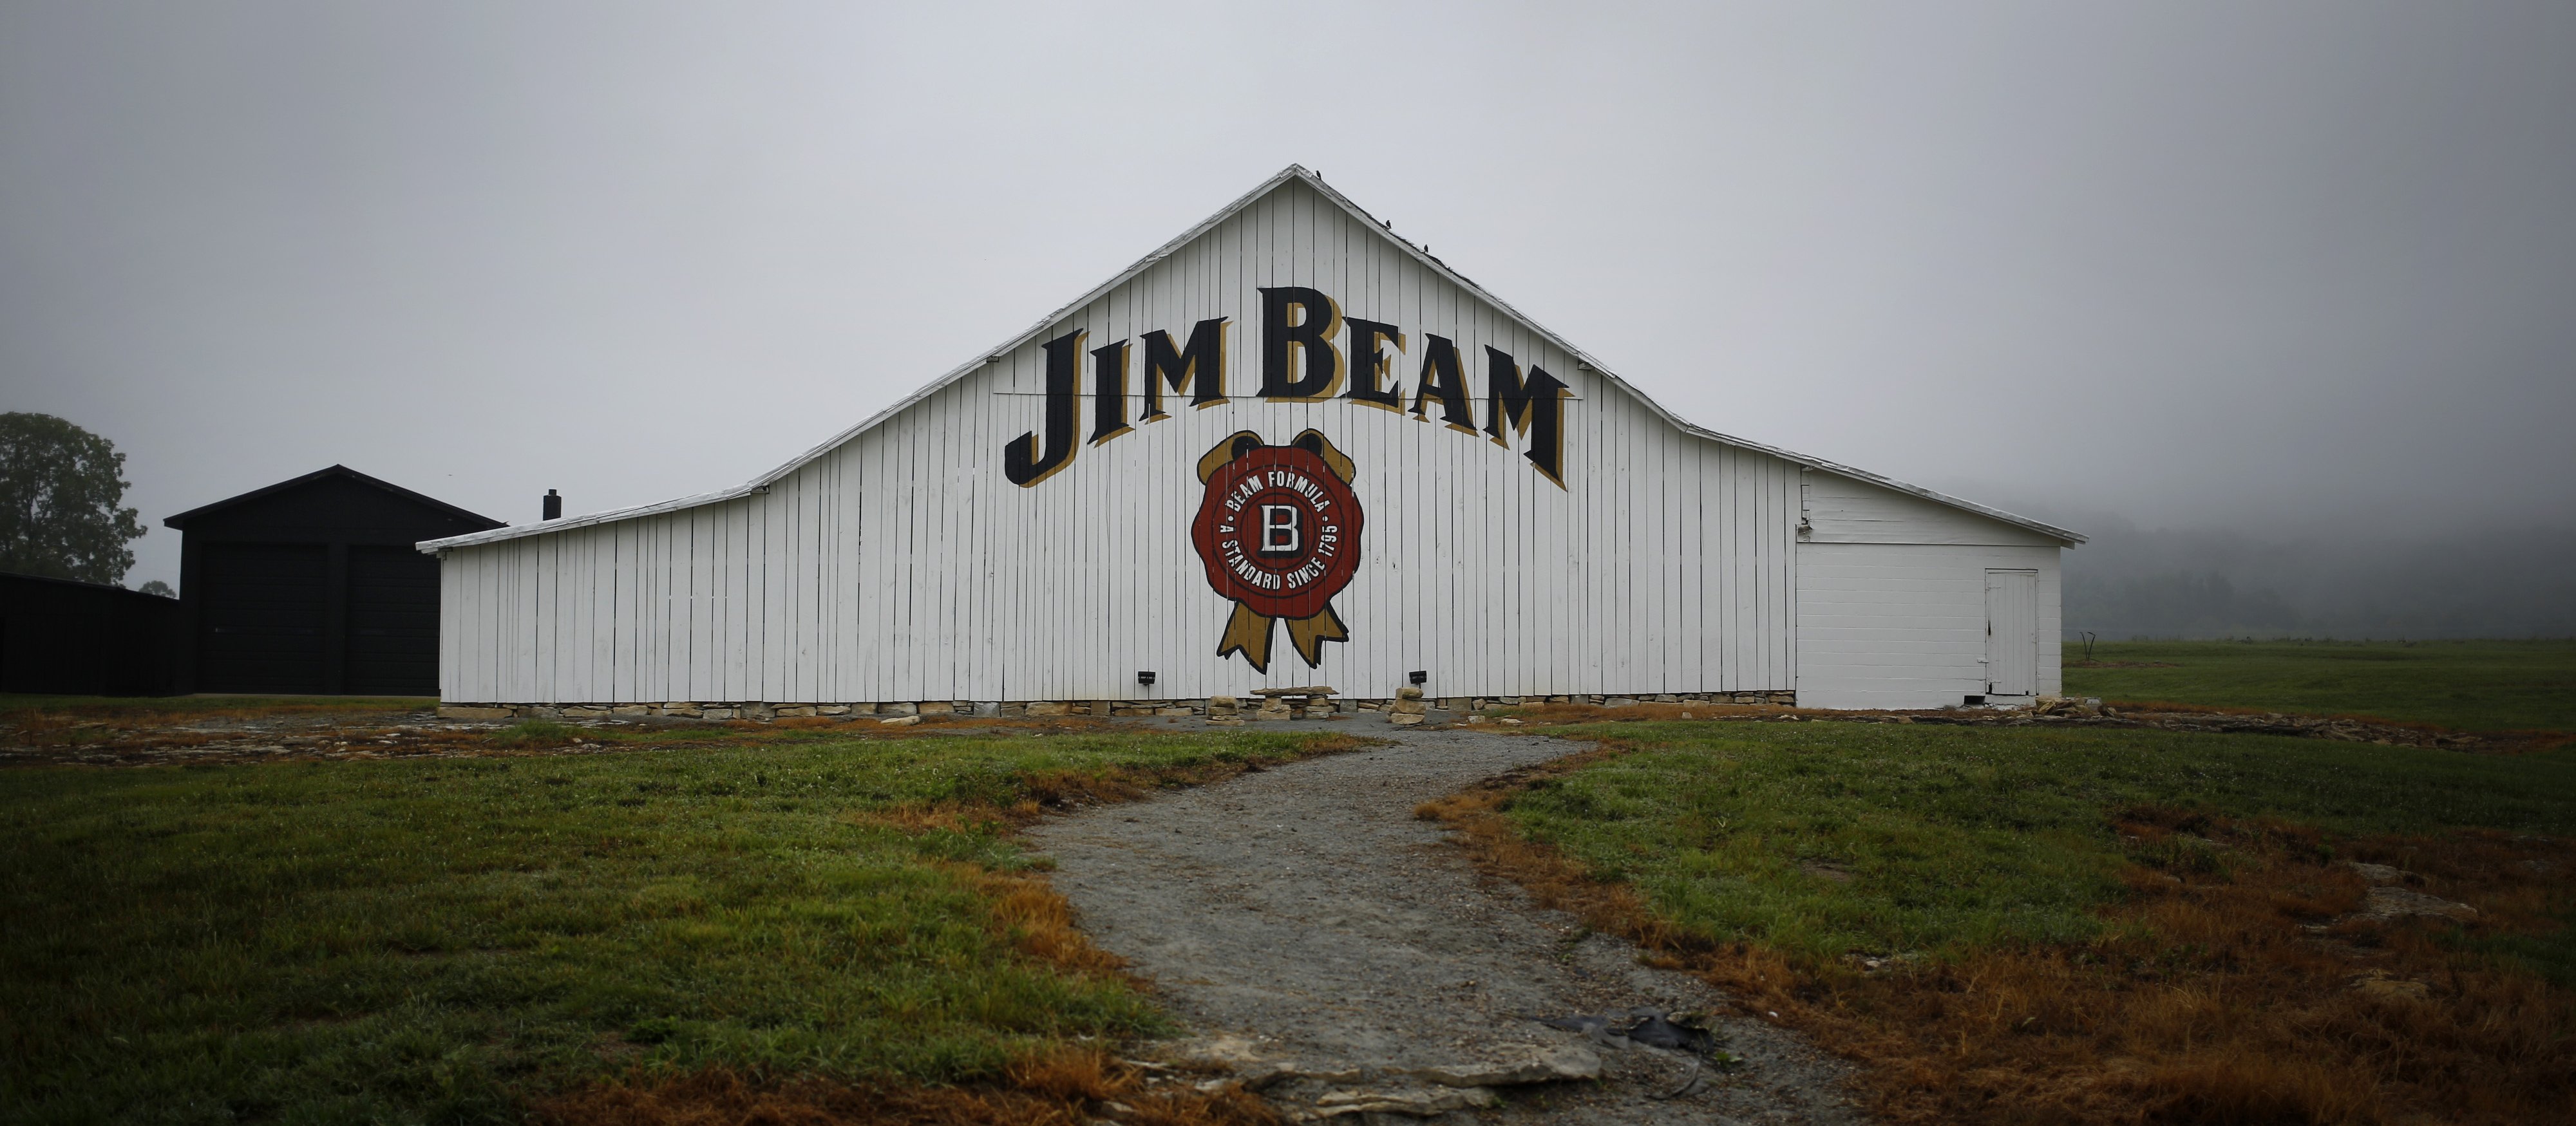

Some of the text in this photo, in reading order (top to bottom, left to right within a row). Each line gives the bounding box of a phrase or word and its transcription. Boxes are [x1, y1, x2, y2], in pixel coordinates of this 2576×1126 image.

[1005, 286, 1575, 492] JIM BEAM
[1224, 471, 1331, 513] BEAM FORMULA
[1258, 505, 1300, 552] B
[1220, 525, 1338, 590] A STANDARD SINCE 1795
